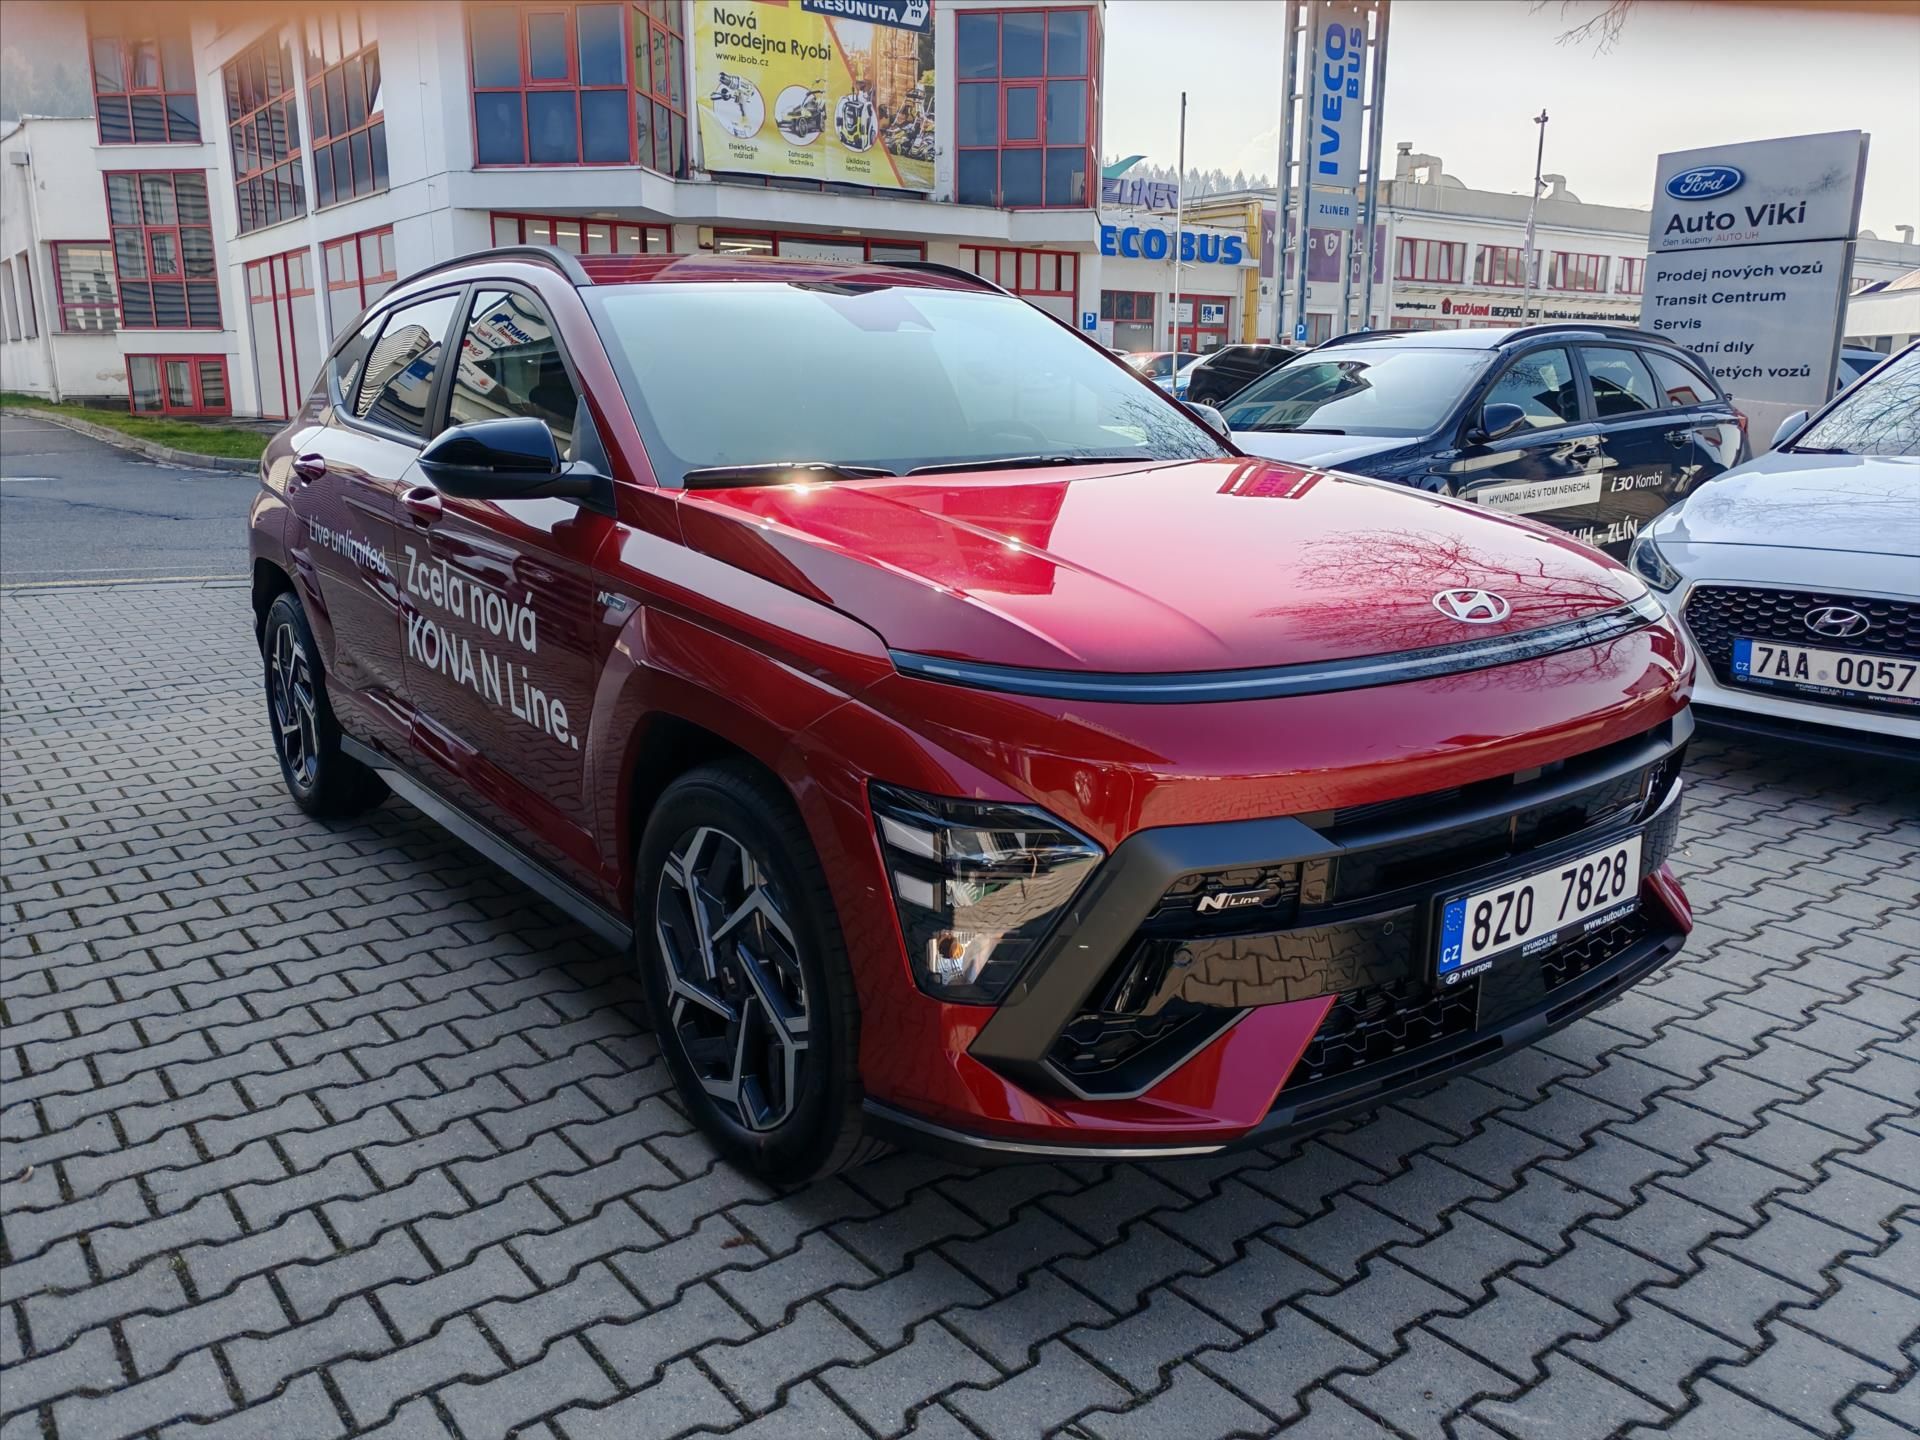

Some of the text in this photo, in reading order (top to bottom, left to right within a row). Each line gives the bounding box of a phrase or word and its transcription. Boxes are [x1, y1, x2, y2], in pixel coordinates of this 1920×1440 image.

[713, 7, 757, 29] Nová
[713, 29, 832, 61] prodejna Ryobi
[715, 52, 769, 67] www.ibob.cz
[1346, 27, 1362, 99] BUS
[1318, 22, 1347, 175] IVECO
[1680, 170, 1724, 194] Ford
[1319, 204, 1349, 217] ZLINER
[1664, 200, 1807, 236] Auto Viki
[1178, 231, 1243, 265] BUS
[1662, 230, 1760, 247] člen skupiny AUTO UH
[1656, 260, 1823, 283] Prodej nových vozů
[1655, 290, 1787, 306] Transit Centrum
[1452, 303, 1490, 317] POŽÁRNÍ
[1653, 317, 1702, 330] Servis
[1768, 364, 1811, 378] vozů
[1488, 492, 1522, 505] HYUNDAI
[1523, 488, 1536, 499] VÁS
[1536, 489, 1543, 497] V
[1543, 486, 1558, 497] TOM
[1559, 480, 1591, 495] NENECHÁ
[1610, 470, 1663, 493] i30 Kombi
[1607, 514, 1639, 544] ZLÍN
[309, 514, 388, 576] Live unlimited.
[404, 544, 537, 654] Zcela nová
[1735, 661, 1749, 671] CZ
[1757, 646, 1918, 693] 7AA 0057
[407, 610, 579, 751] KONA N Line.
[1557, 849, 1628, 922] 7828
[1230, 896, 1260, 906] Line
[1583, 903, 1636, 932] www.autouh.cz
[1442, 944, 1460, 963] CZ
[1461, 961, 1493, 979] HYUNDAI
